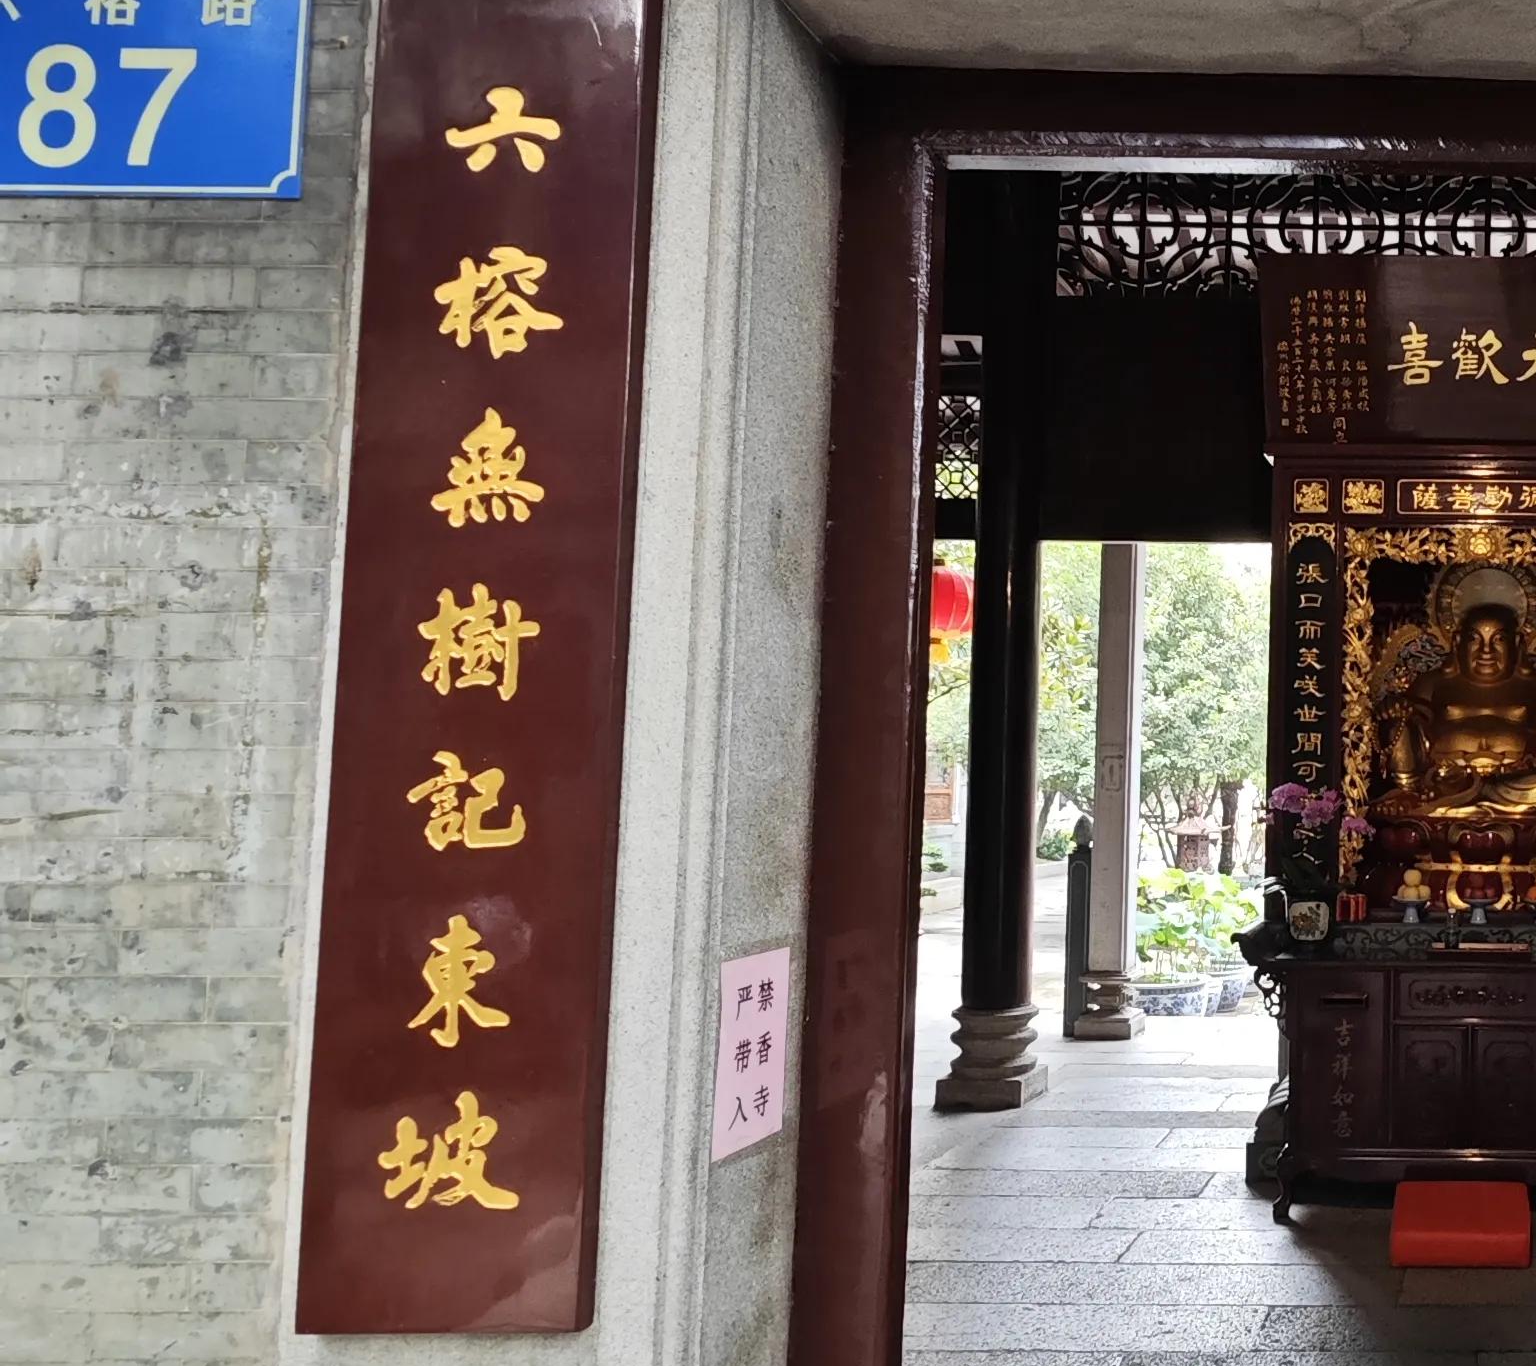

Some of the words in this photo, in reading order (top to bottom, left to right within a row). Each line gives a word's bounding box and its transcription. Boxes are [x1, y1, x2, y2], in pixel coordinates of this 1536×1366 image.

[18, 43, 198, 169] 87
[735, 976, 776, 1022] 严禁
[733, 1030, 773, 1074] 带香
[727, 1084, 771, 1132] 入寺
